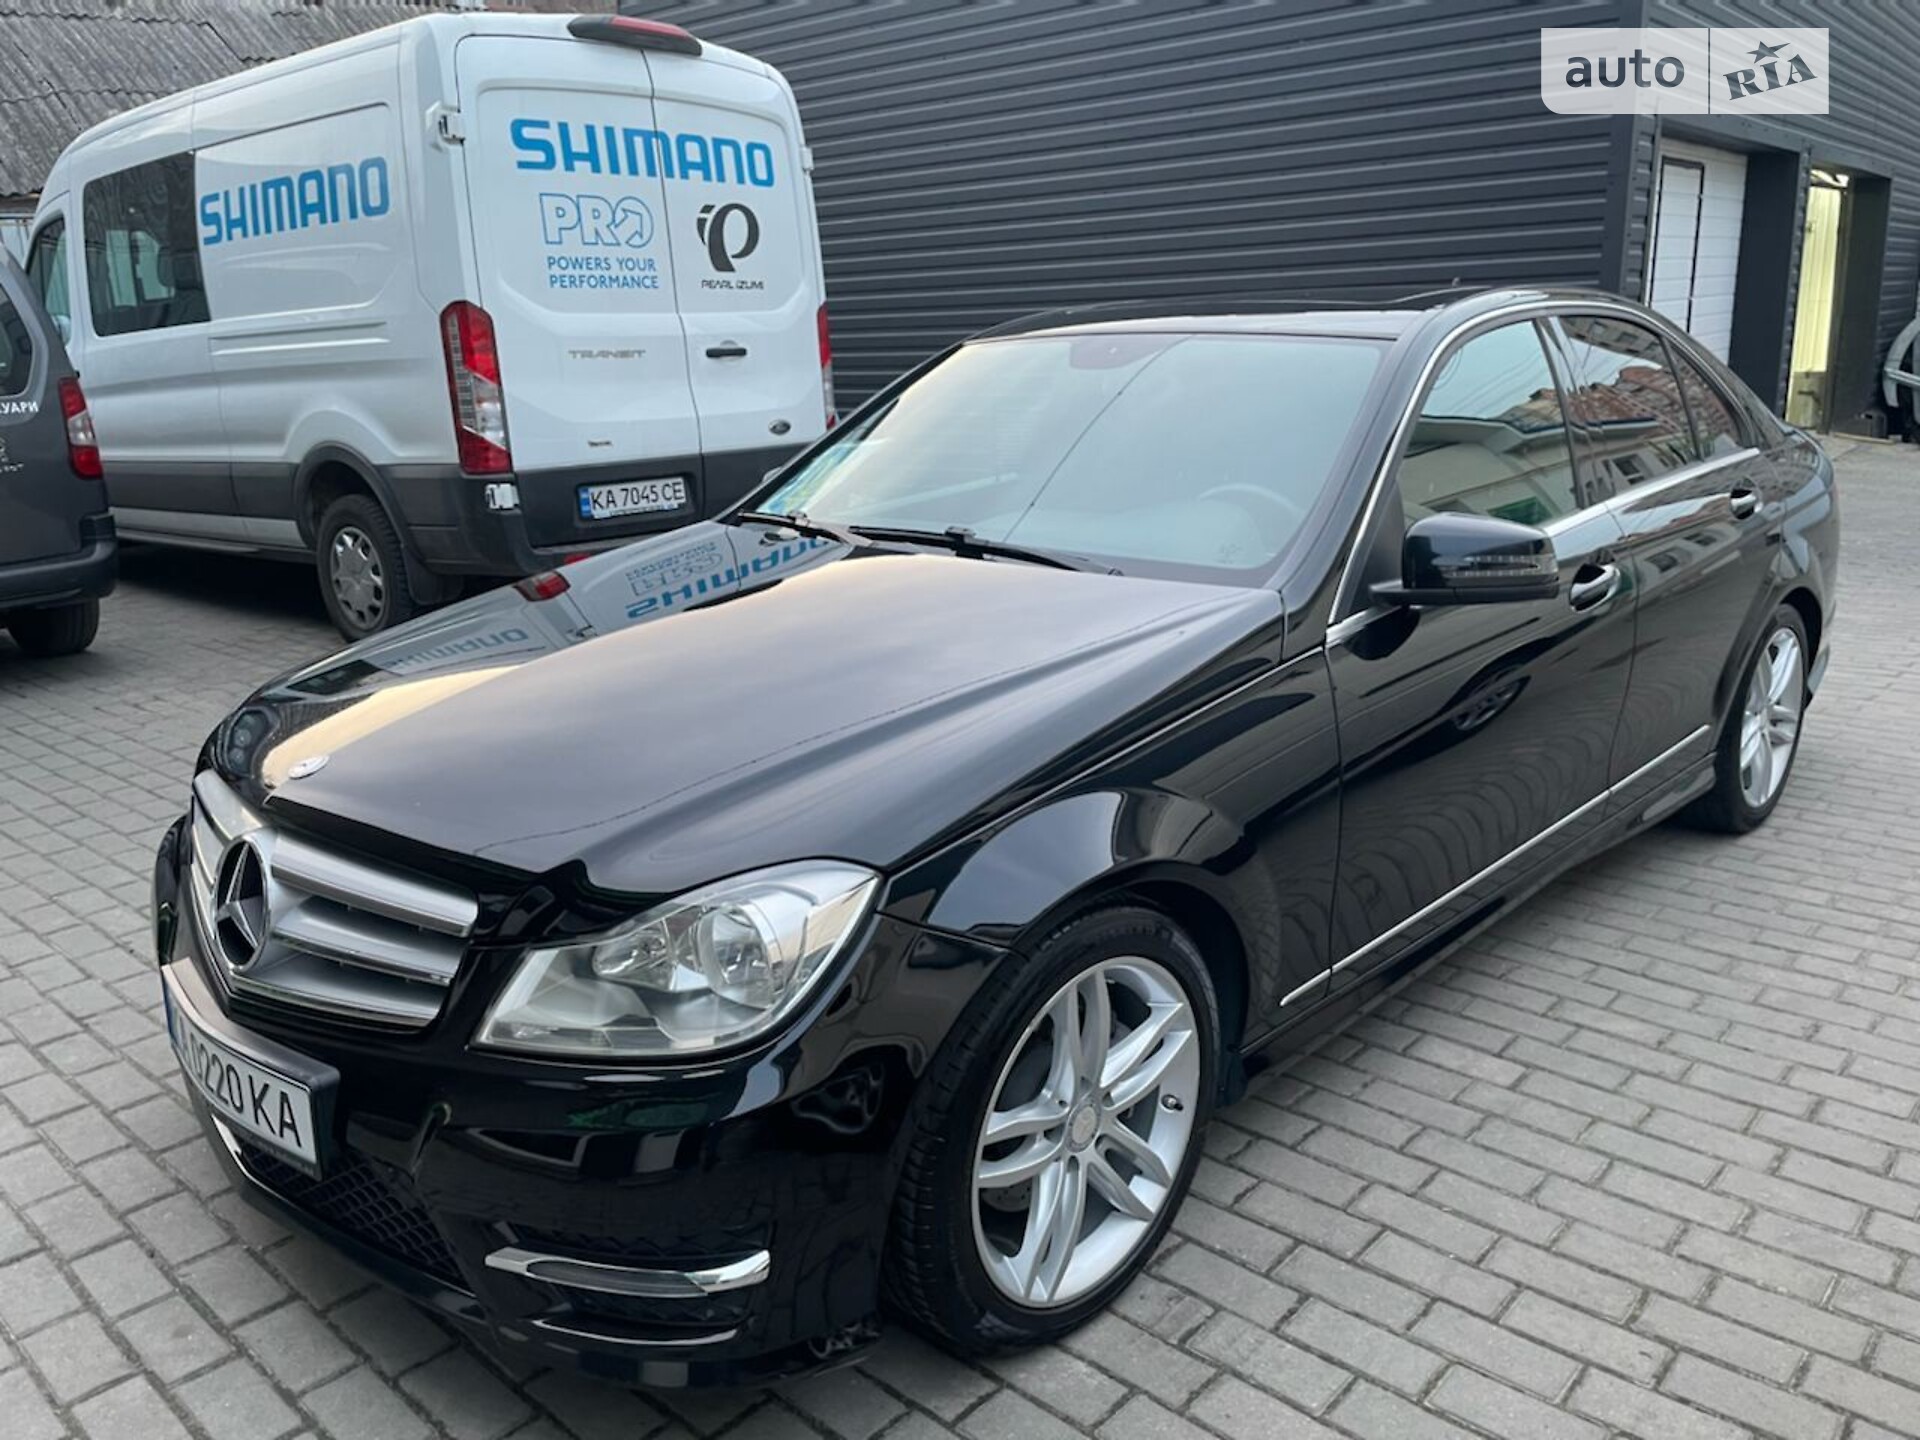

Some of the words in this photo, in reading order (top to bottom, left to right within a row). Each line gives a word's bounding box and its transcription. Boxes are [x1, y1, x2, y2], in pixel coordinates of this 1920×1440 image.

[510, 118, 775, 187] SHIMANO
[200, 156, 390, 246] SHIMANO
[539, 192, 654, 248] PRO
[547, 256, 611, 271] POWERS
[616, 258, 656, 271] YOUR
[549, 275, 659, 289] PERFORMANCE
[701, 279, 734, 289] PEARL
[0, 401, 39, 414] УАРИ
[591, 489, 618, 510] KA
[620, 485, 658, 506] 7045
[662, 482, 684, 501] CE
[248, 1073, 302, 1149] KA
